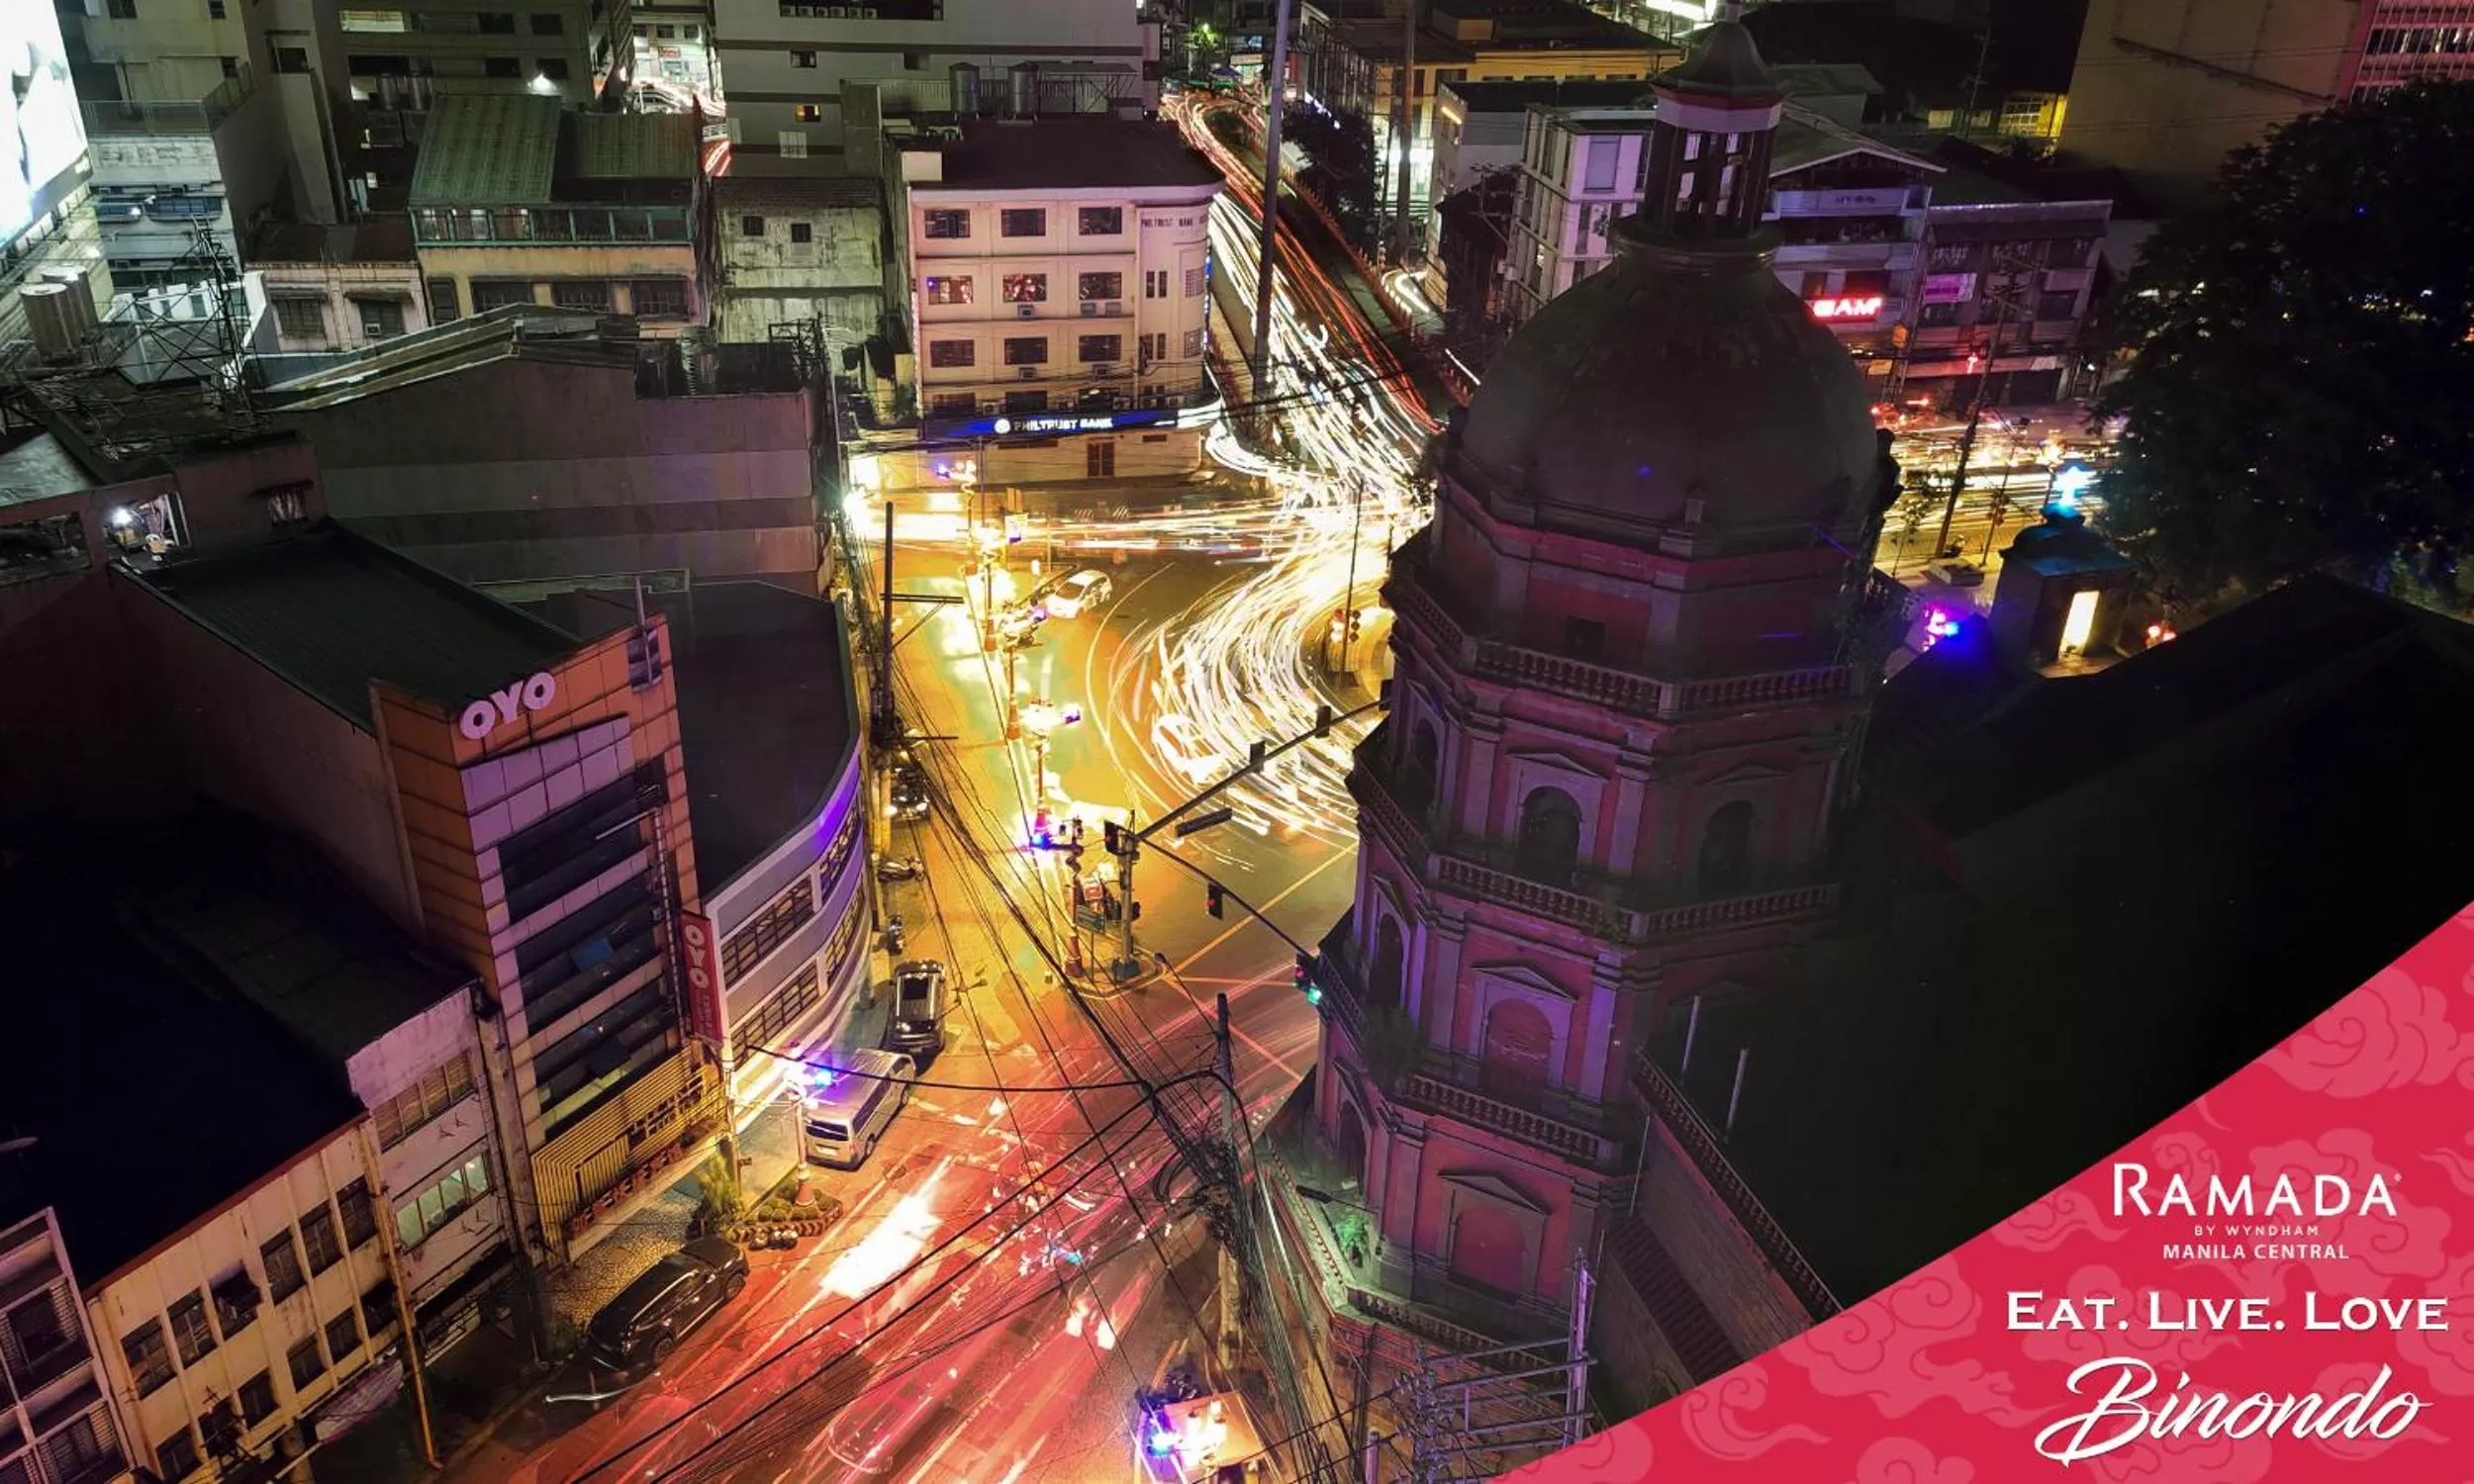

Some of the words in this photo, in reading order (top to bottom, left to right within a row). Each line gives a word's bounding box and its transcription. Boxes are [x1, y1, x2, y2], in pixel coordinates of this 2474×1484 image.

[1080, 417, 1113, 428] BANK
[459, 672, 555, 740] OYO
[684, 924, 710, 989] OYO
